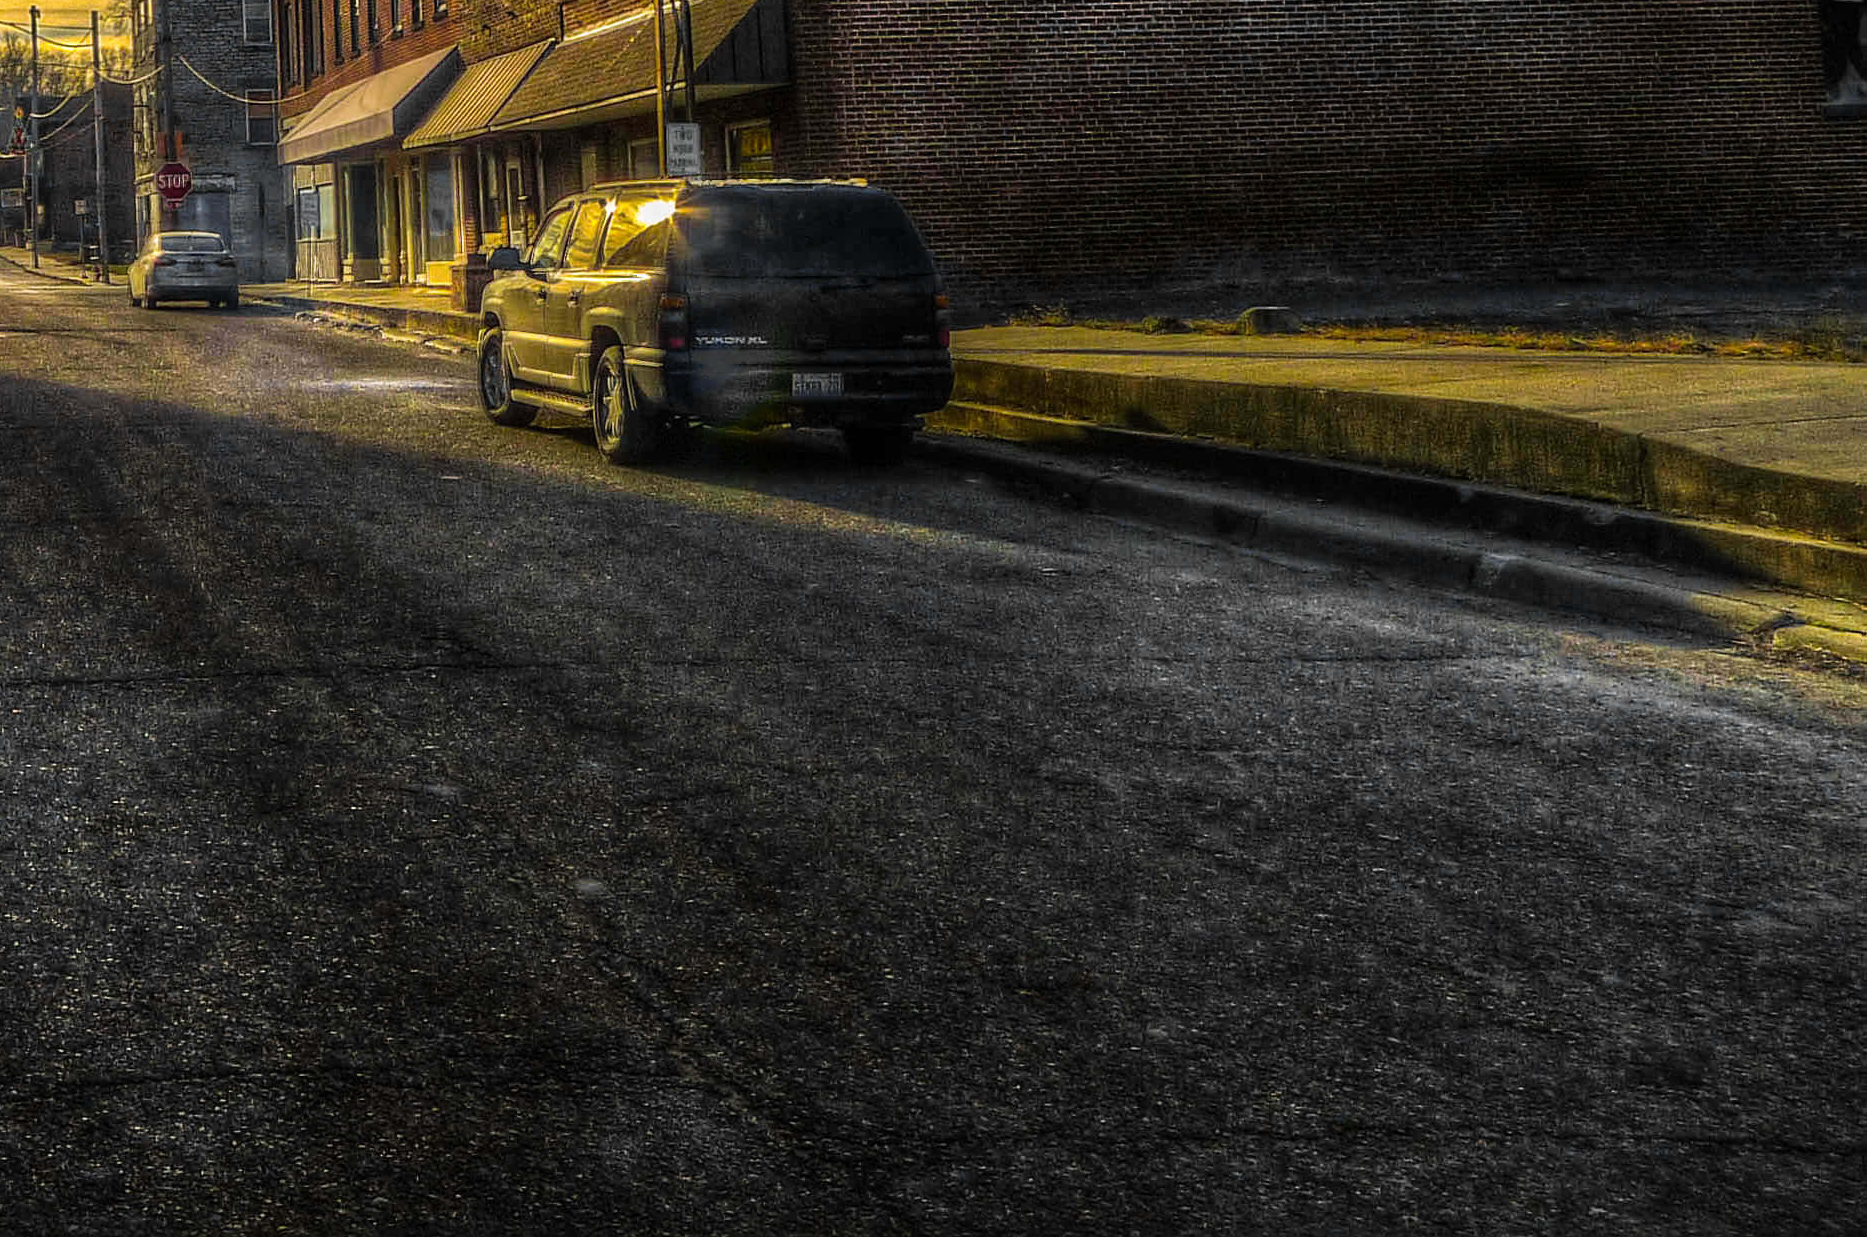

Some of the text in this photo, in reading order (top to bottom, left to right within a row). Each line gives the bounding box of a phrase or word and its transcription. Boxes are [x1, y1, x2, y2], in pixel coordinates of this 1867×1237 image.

[158, 173, 190, 189] STOP
[694, 336, 769, 345] YUKON XL
